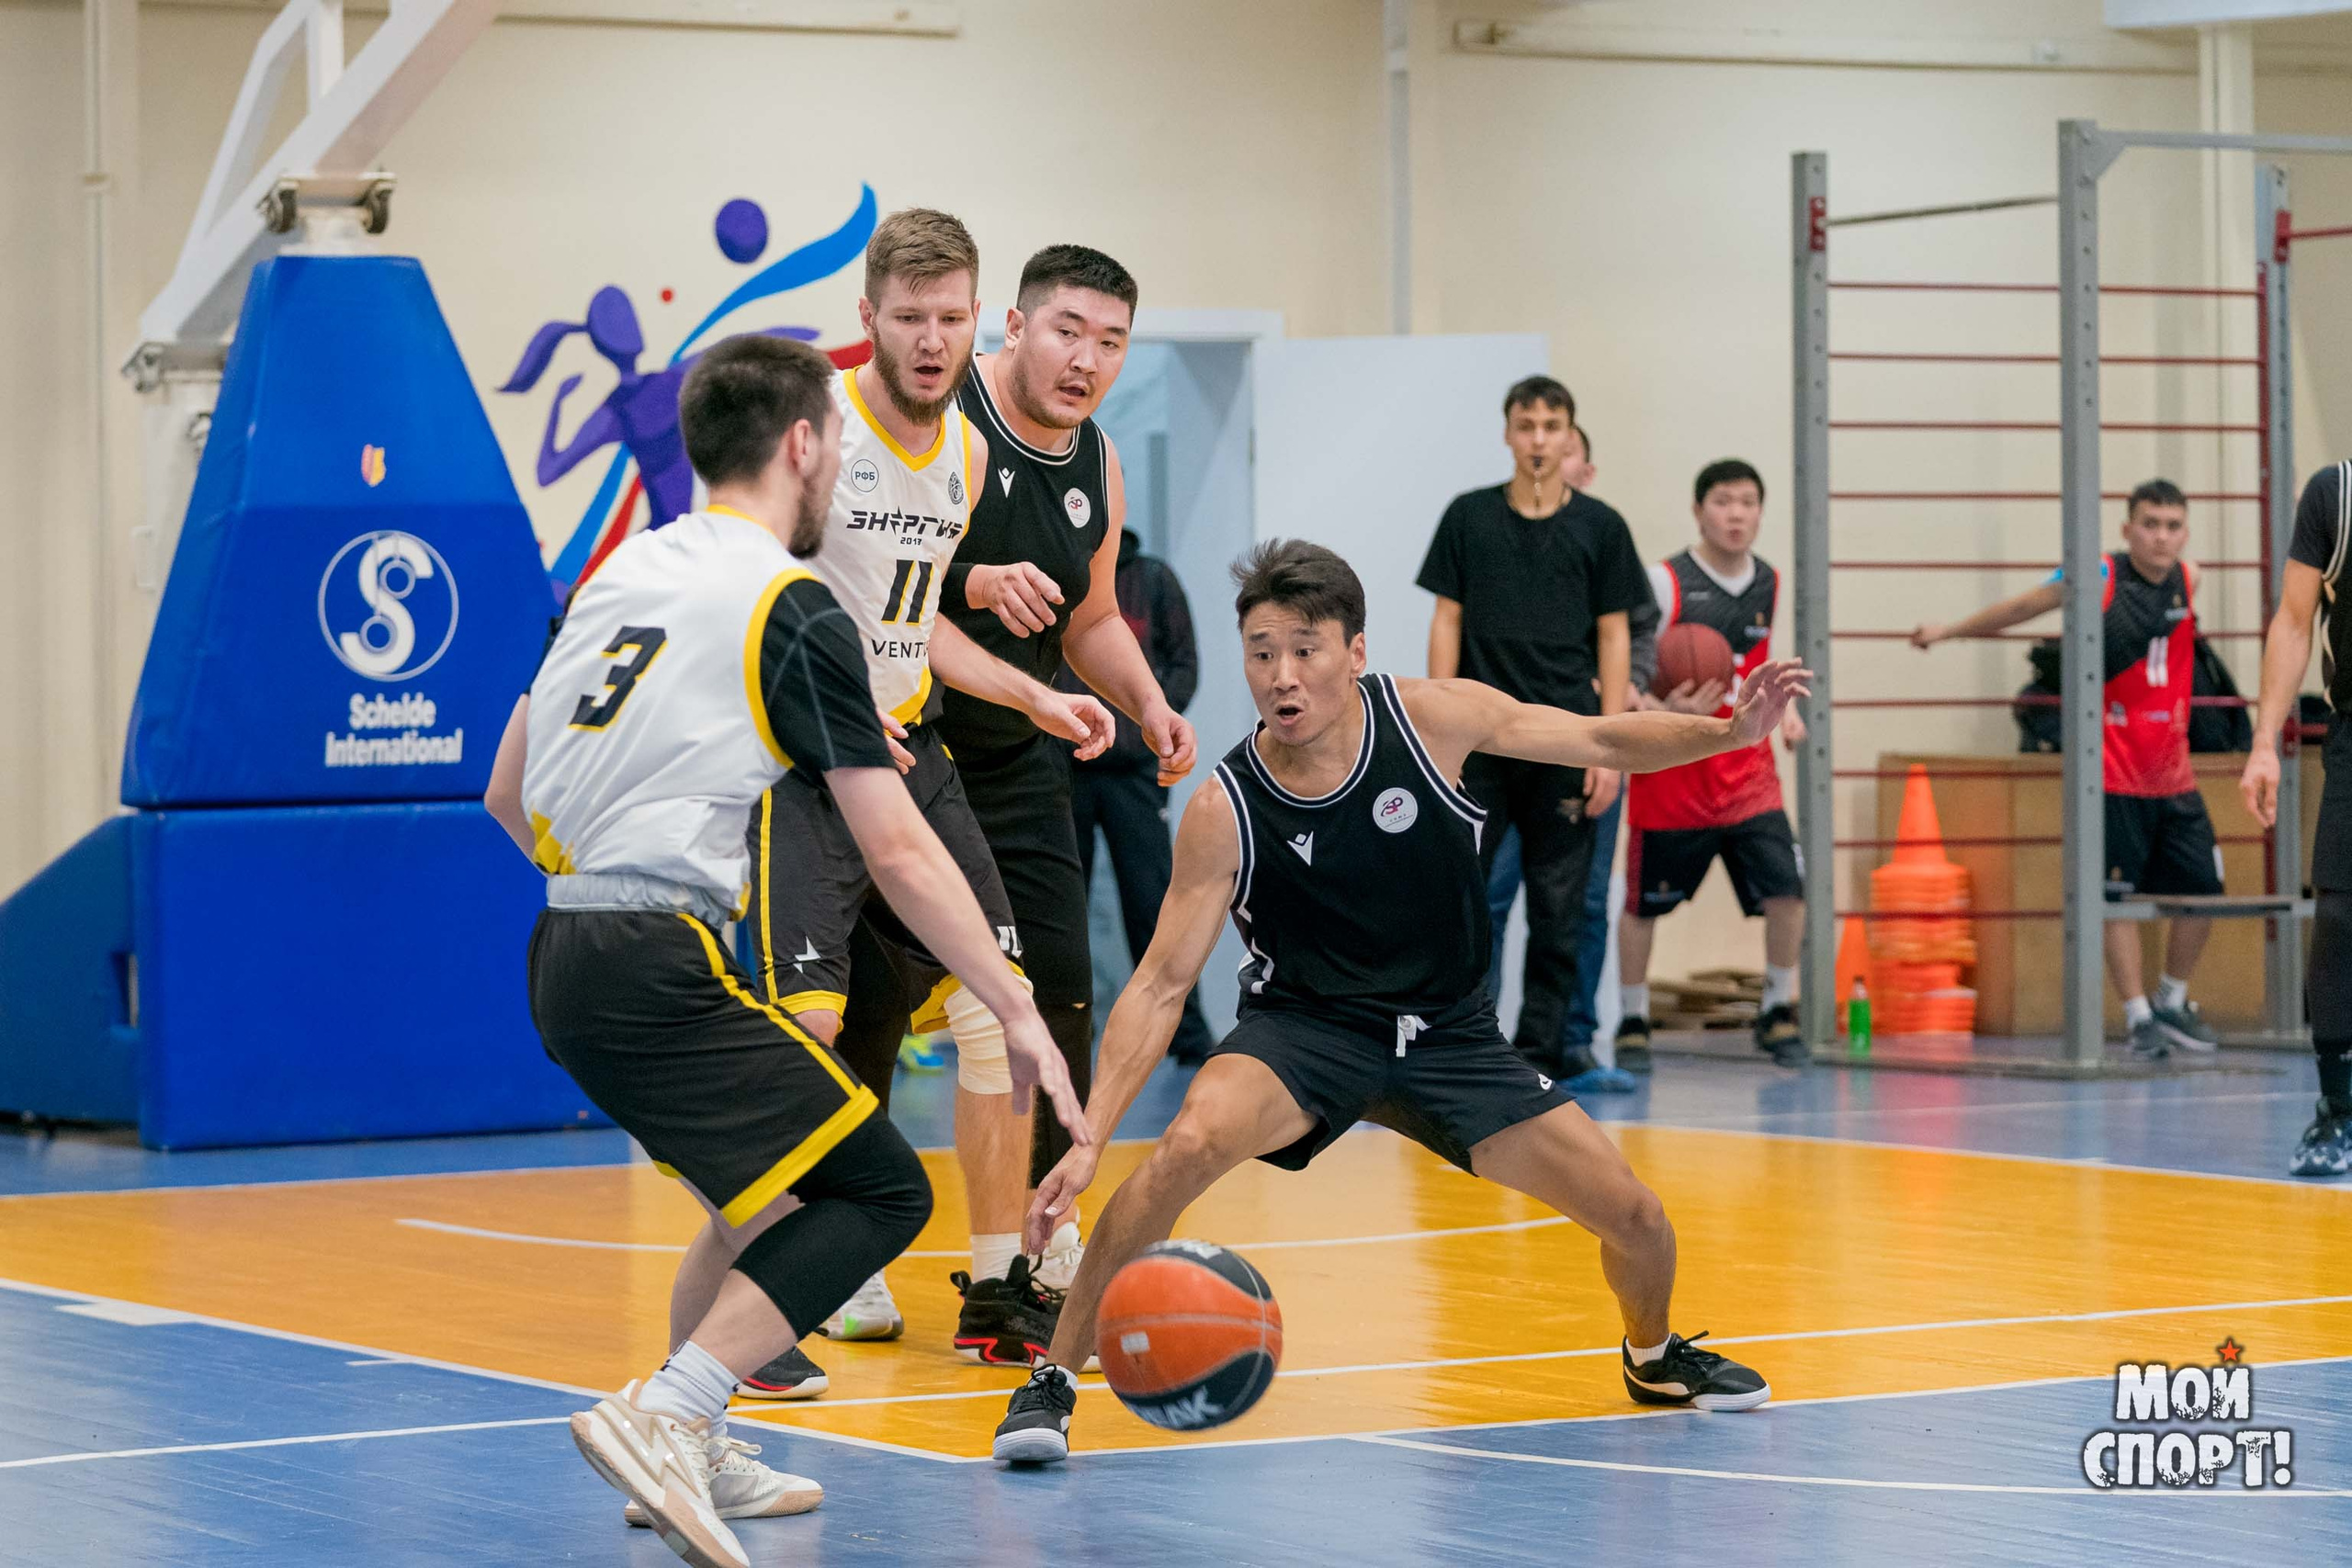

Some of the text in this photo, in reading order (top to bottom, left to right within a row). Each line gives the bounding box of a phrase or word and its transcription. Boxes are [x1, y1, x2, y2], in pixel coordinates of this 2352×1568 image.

[854, 470, 876, 481] РФБ
[880, 558, 933, 626] 11
[567, 625, 668, 733] 3
[2145, 636, 2169, 688] 11
[349, 692, 437, 730] Schelde
[324, 728, 464, 768] International
